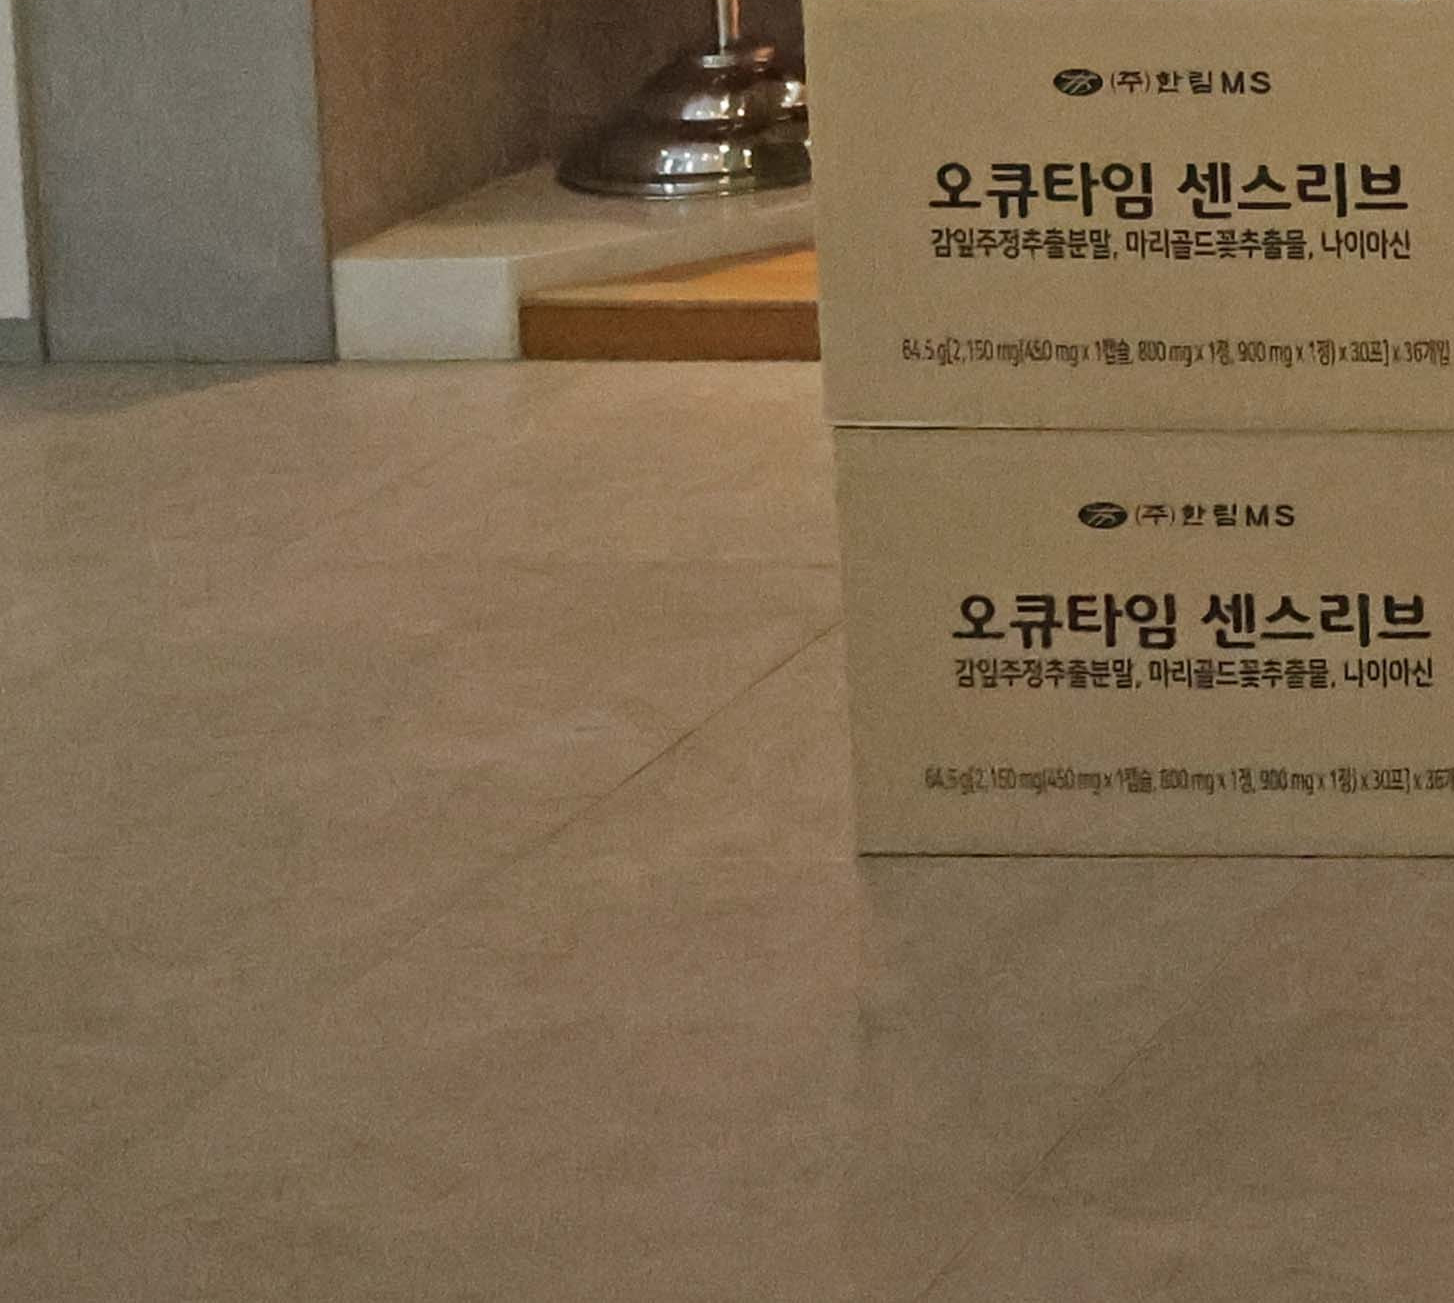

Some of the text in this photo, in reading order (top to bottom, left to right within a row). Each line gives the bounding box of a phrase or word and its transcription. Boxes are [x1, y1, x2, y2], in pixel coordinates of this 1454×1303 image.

[929, 161, 1409, 220] 오큐타임 센스리브
[1055, 344, 1079, 367] mg
[1169, 344, 1192, 367] mg
[1269, 344, 1292, 367] mg
[952, 593, 1432, 650] 오큐타임 센스리브
[1343, 658, 1434, 689] 나이아신
